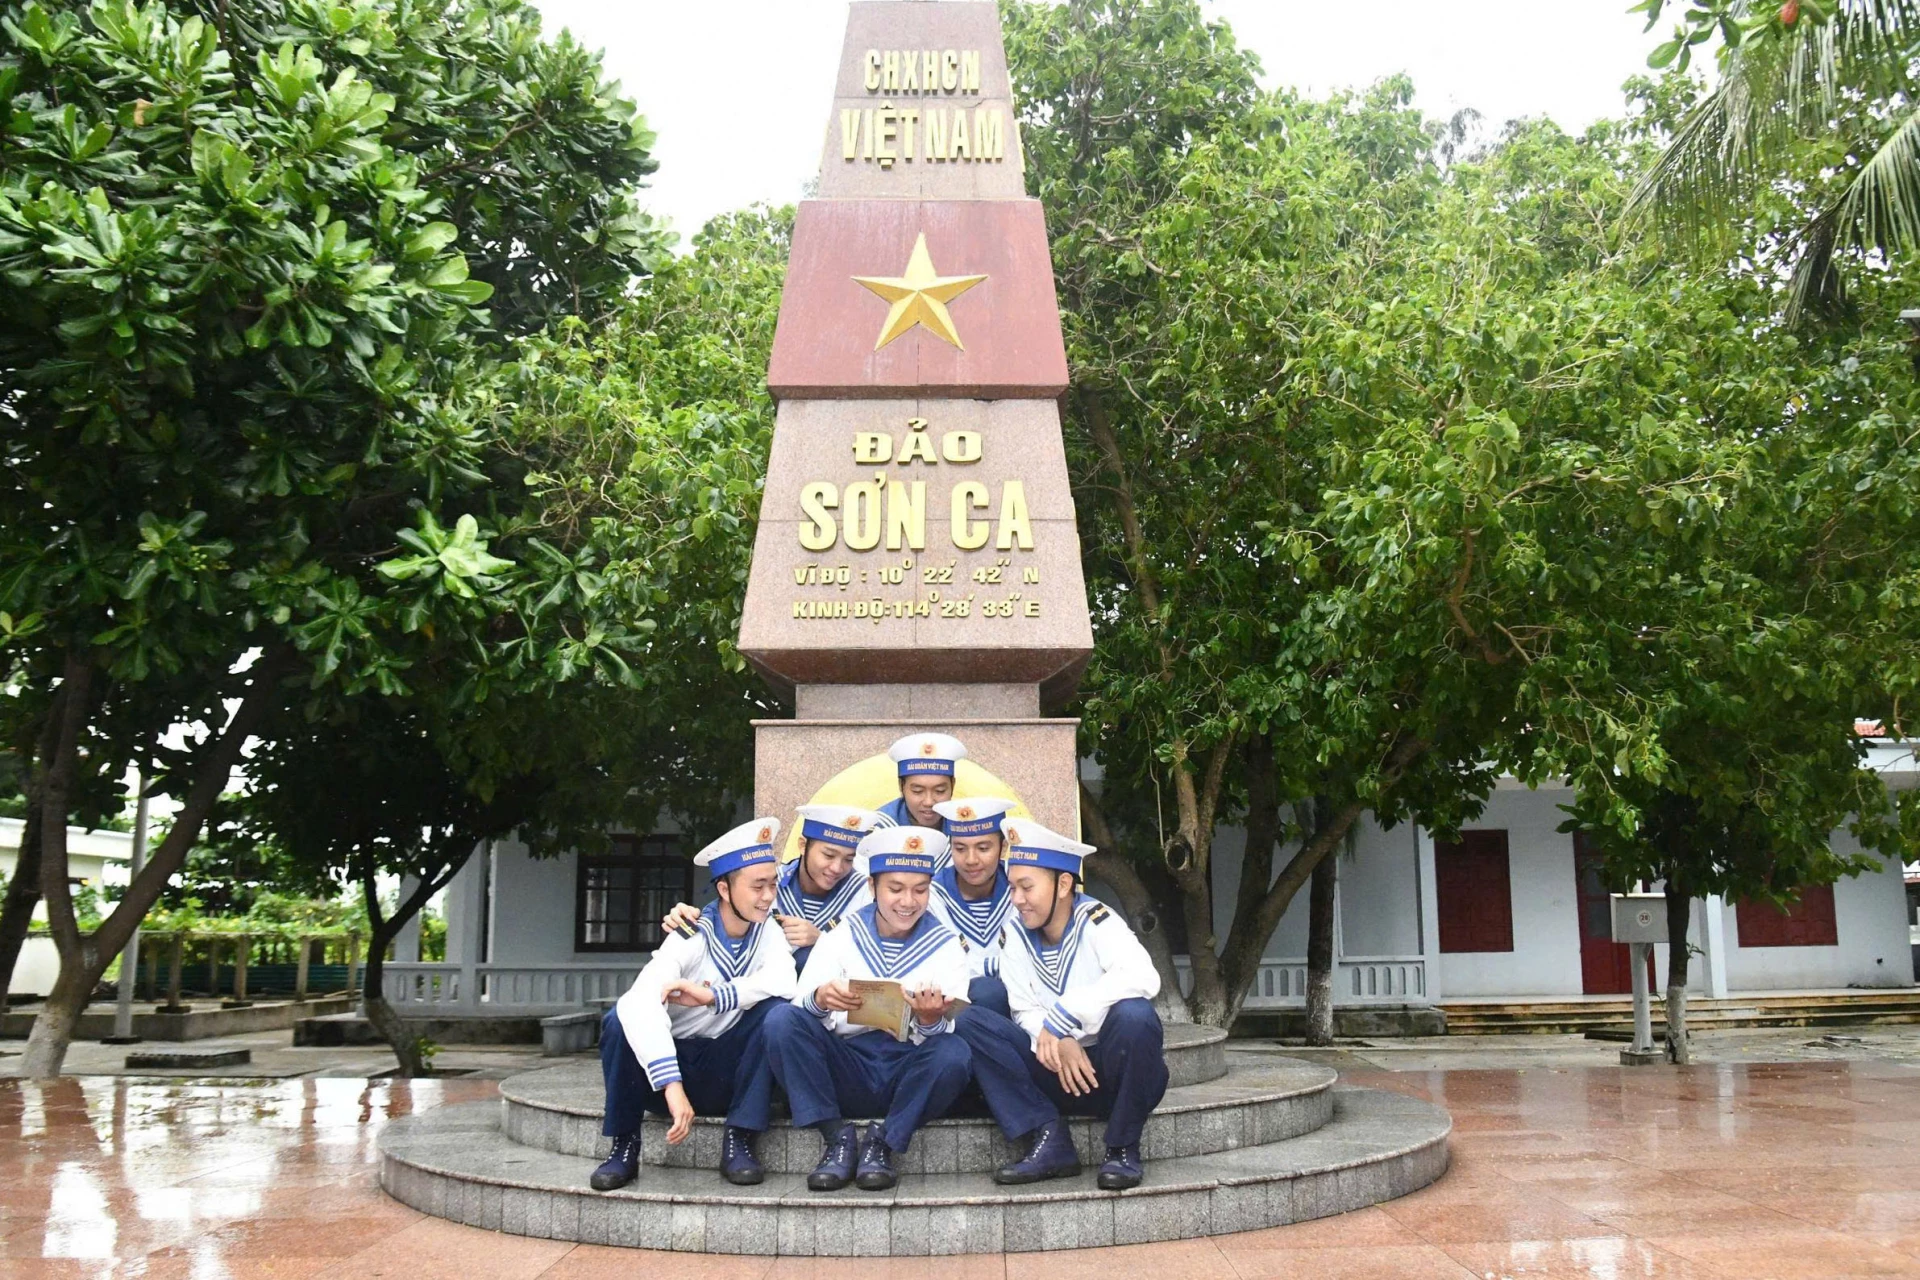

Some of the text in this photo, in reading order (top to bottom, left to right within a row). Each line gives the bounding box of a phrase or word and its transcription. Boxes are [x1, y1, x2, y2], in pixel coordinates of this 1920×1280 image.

[864, 49, 980, 94] CHXHCN
[840, 100, 1003, 171] VIỆT NAM
[852, 417, 983, 465] ĐẢO
[799, 471, 1035, 551] SƠN CA
[794, 562, 818, 584] VĨ
[820, 564, 850, 591] ĐỘ
[1023, 567, 1040, 584] N
[793, 601, 849, 618] KINH
[1025, 602, 1040, 618] E
